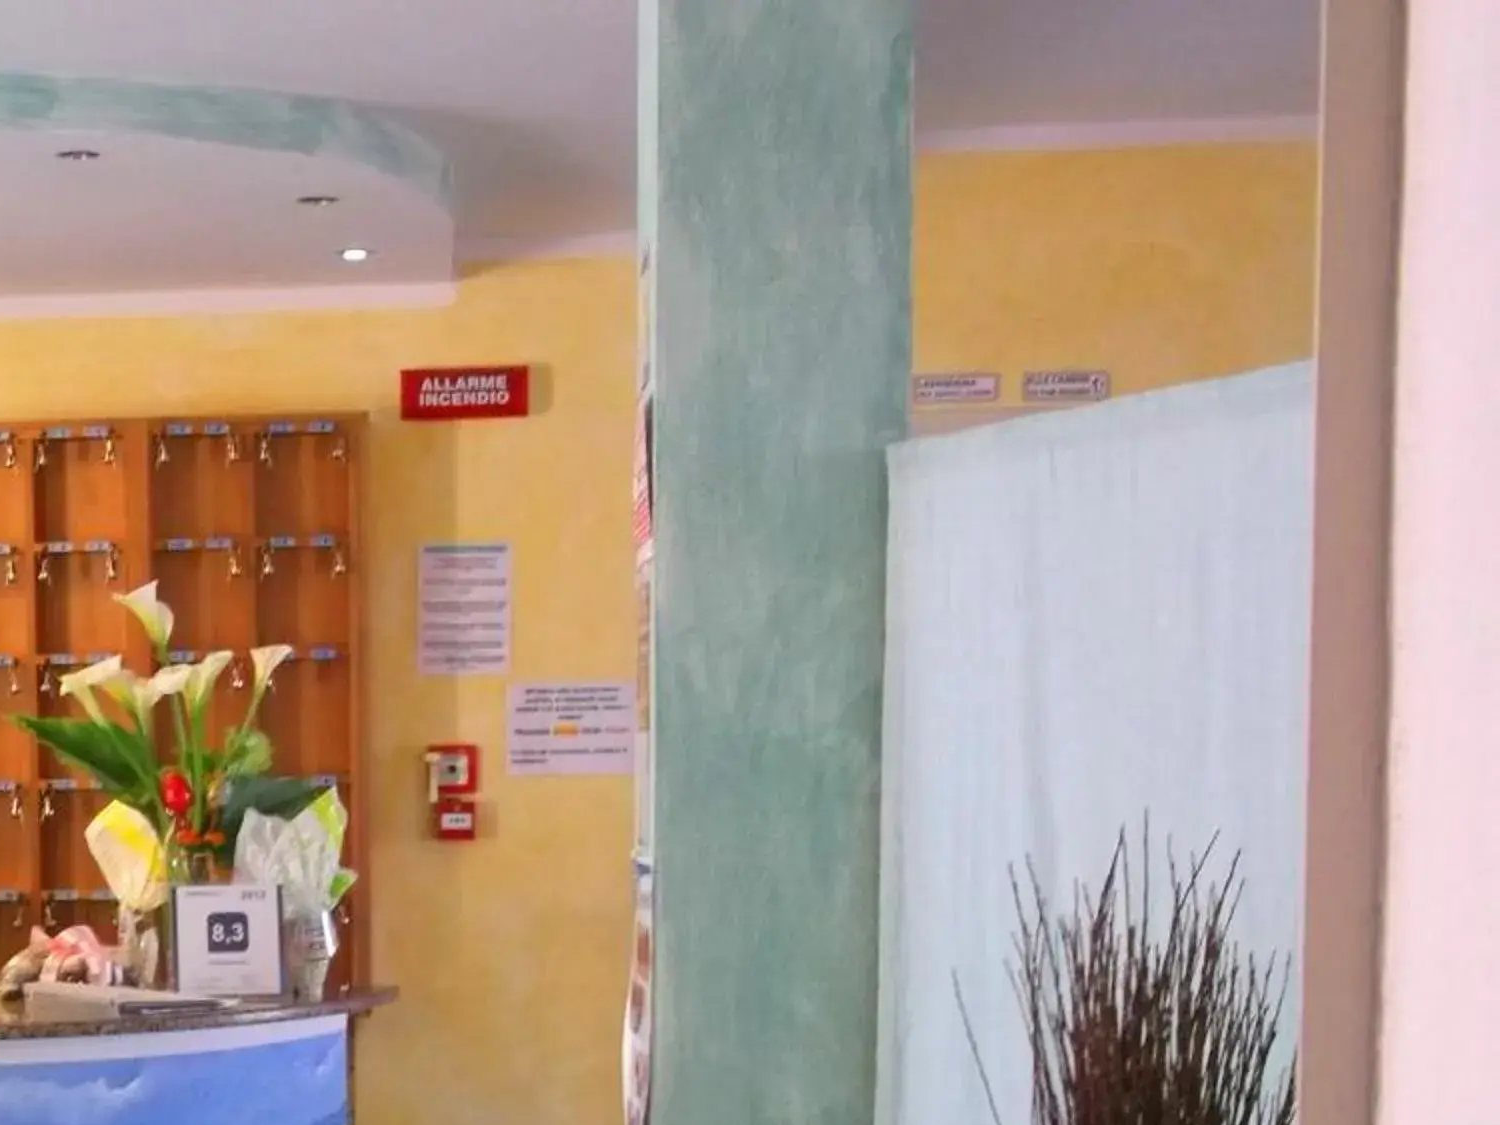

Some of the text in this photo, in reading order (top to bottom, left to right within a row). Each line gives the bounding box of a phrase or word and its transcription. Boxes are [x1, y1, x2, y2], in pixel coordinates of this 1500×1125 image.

[420, 374, 508, 391] ALLARME
[419, 390, 511, 407] INCENDIO
[211, 921, 245, 945] 8,3
